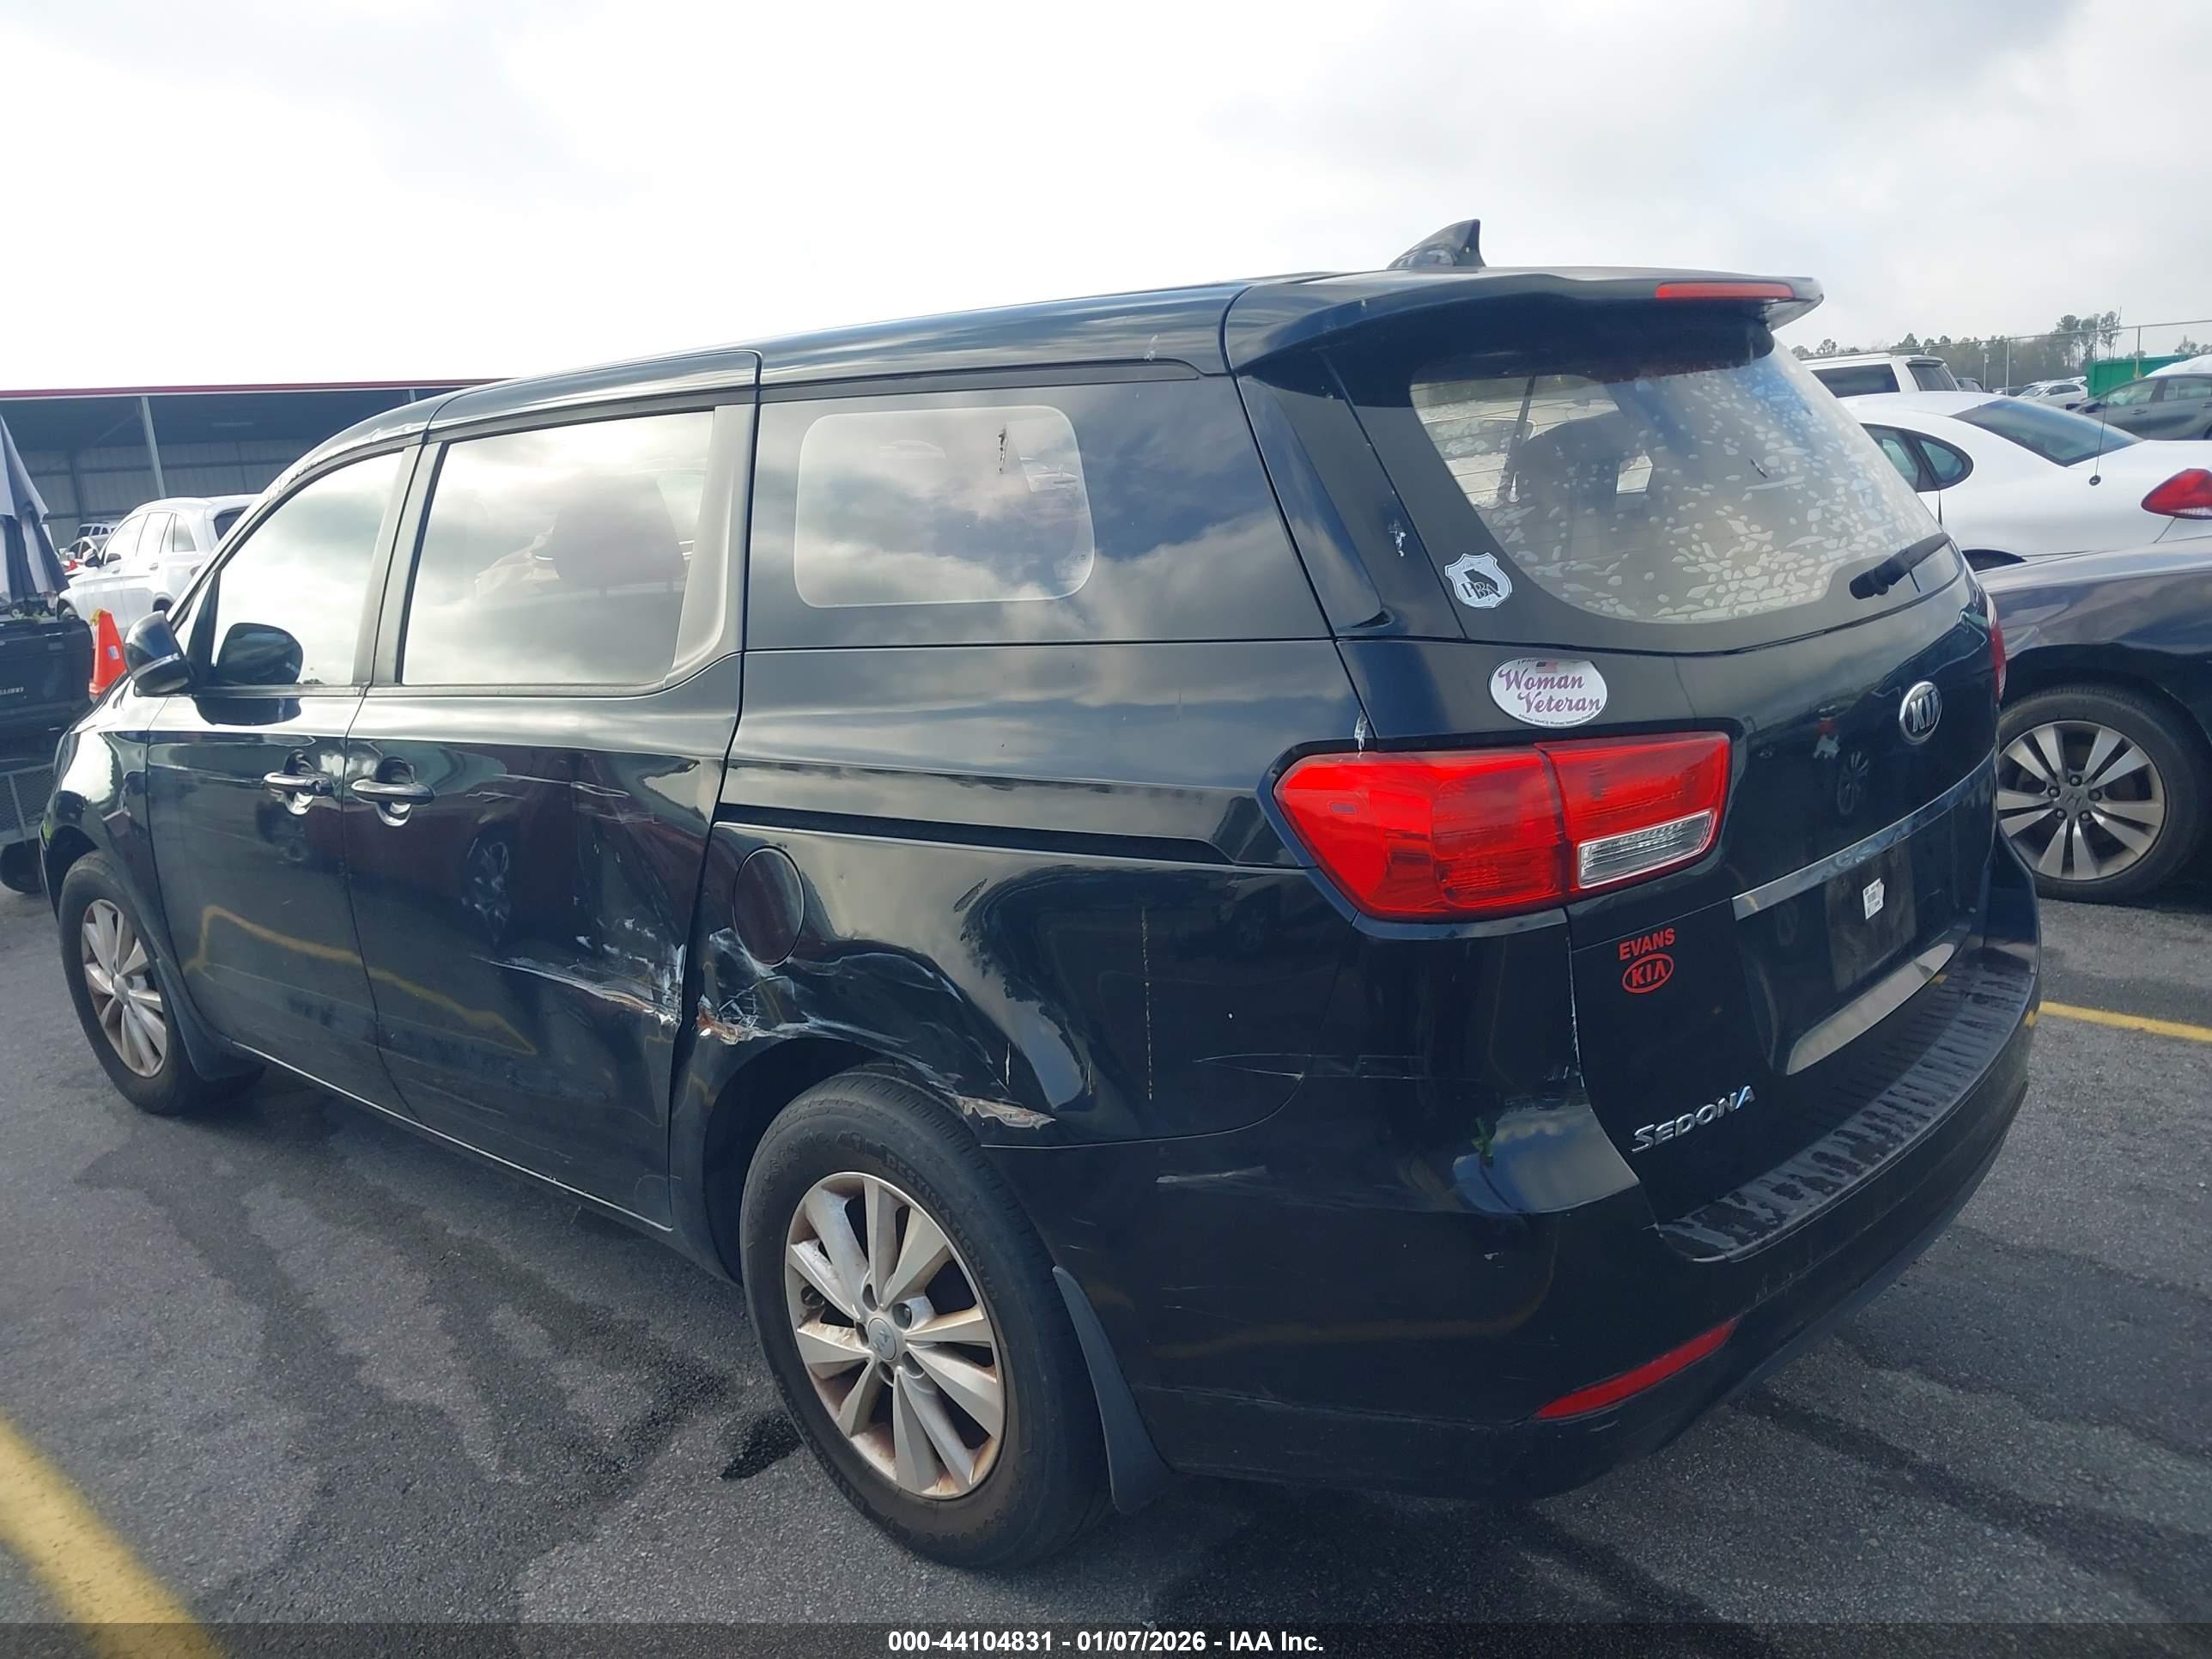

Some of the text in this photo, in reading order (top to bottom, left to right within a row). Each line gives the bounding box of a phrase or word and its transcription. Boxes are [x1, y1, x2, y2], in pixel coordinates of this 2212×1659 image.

[1498, 668, 1584, 691] Woman
[1516, 691, 1602, 714] Veteran
[1620, 927, 1675, 961] EVANS
[1632, 960, 1666, 988] KIA
[1632, 1085, 1756, 1153] SEDONA
